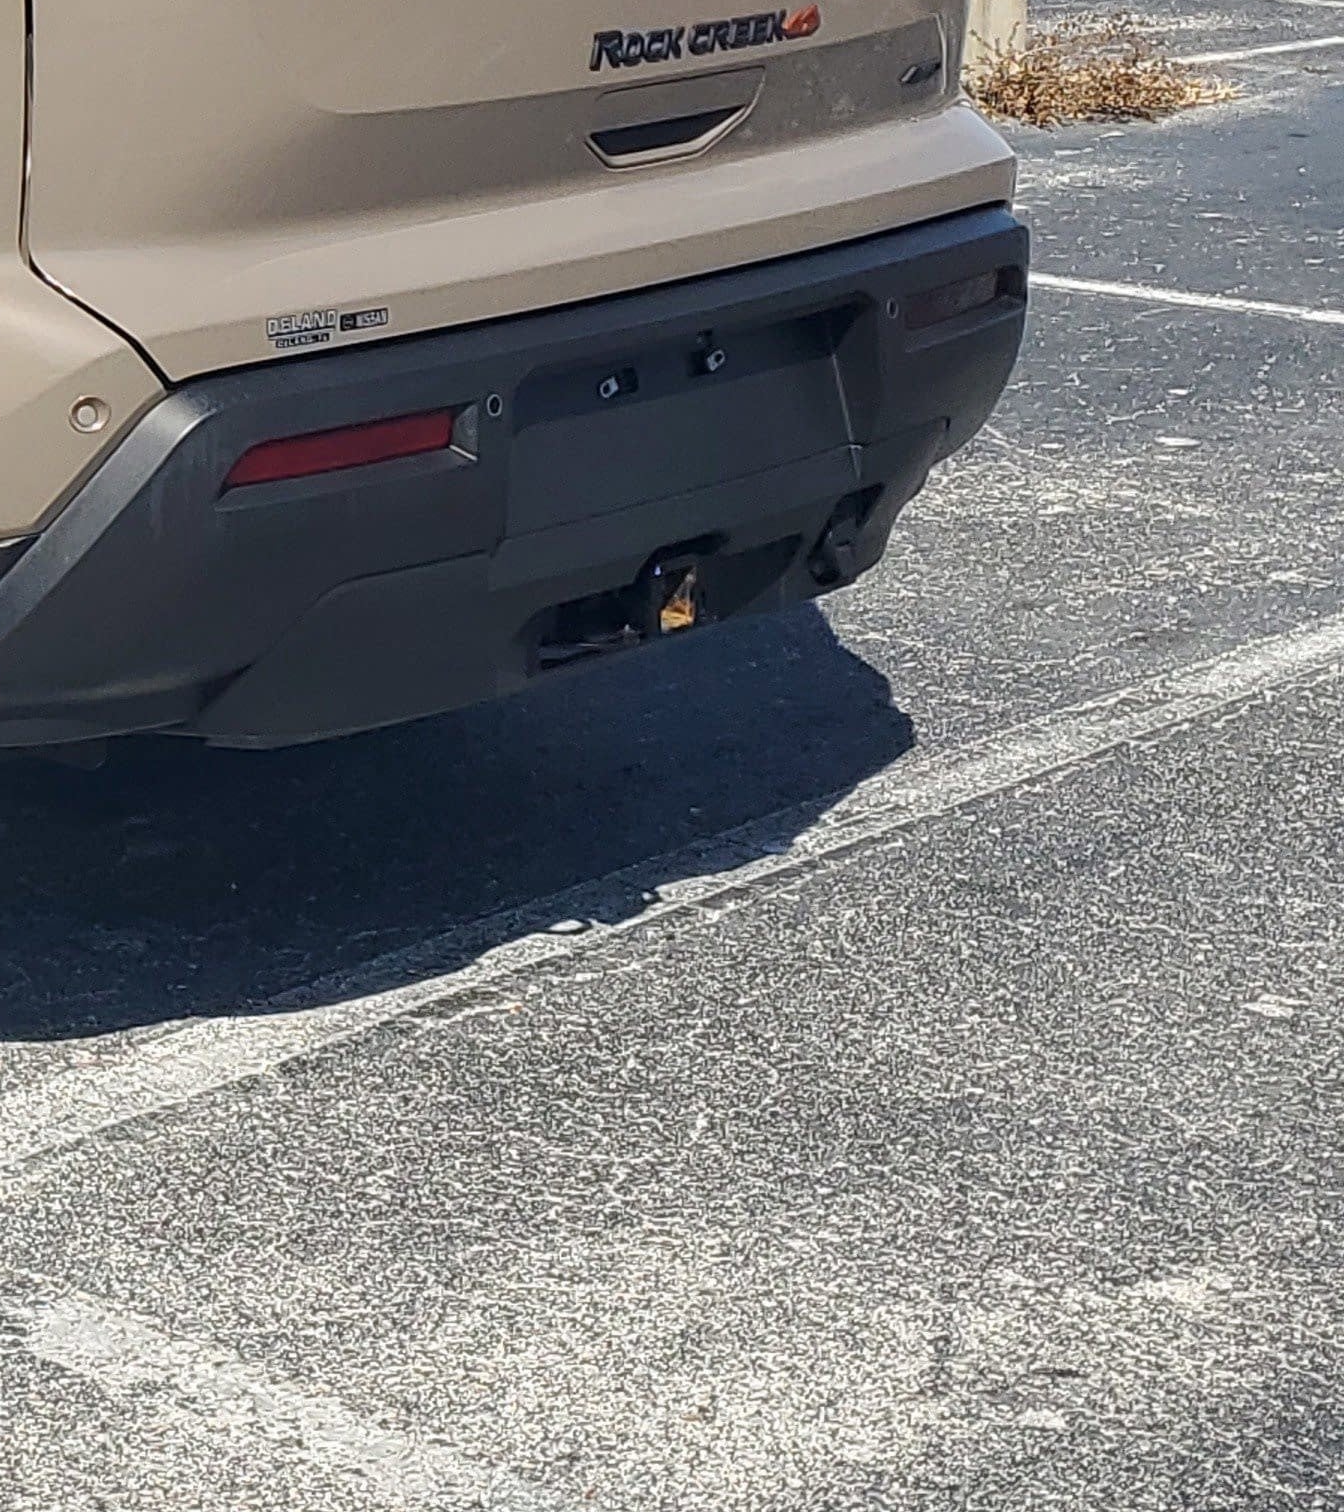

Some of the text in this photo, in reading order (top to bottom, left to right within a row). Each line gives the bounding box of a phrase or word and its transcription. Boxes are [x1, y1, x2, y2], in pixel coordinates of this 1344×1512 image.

[589, 8, 788, 72] ROCK CREEK
[267, 308, 338, 338] DELAND
